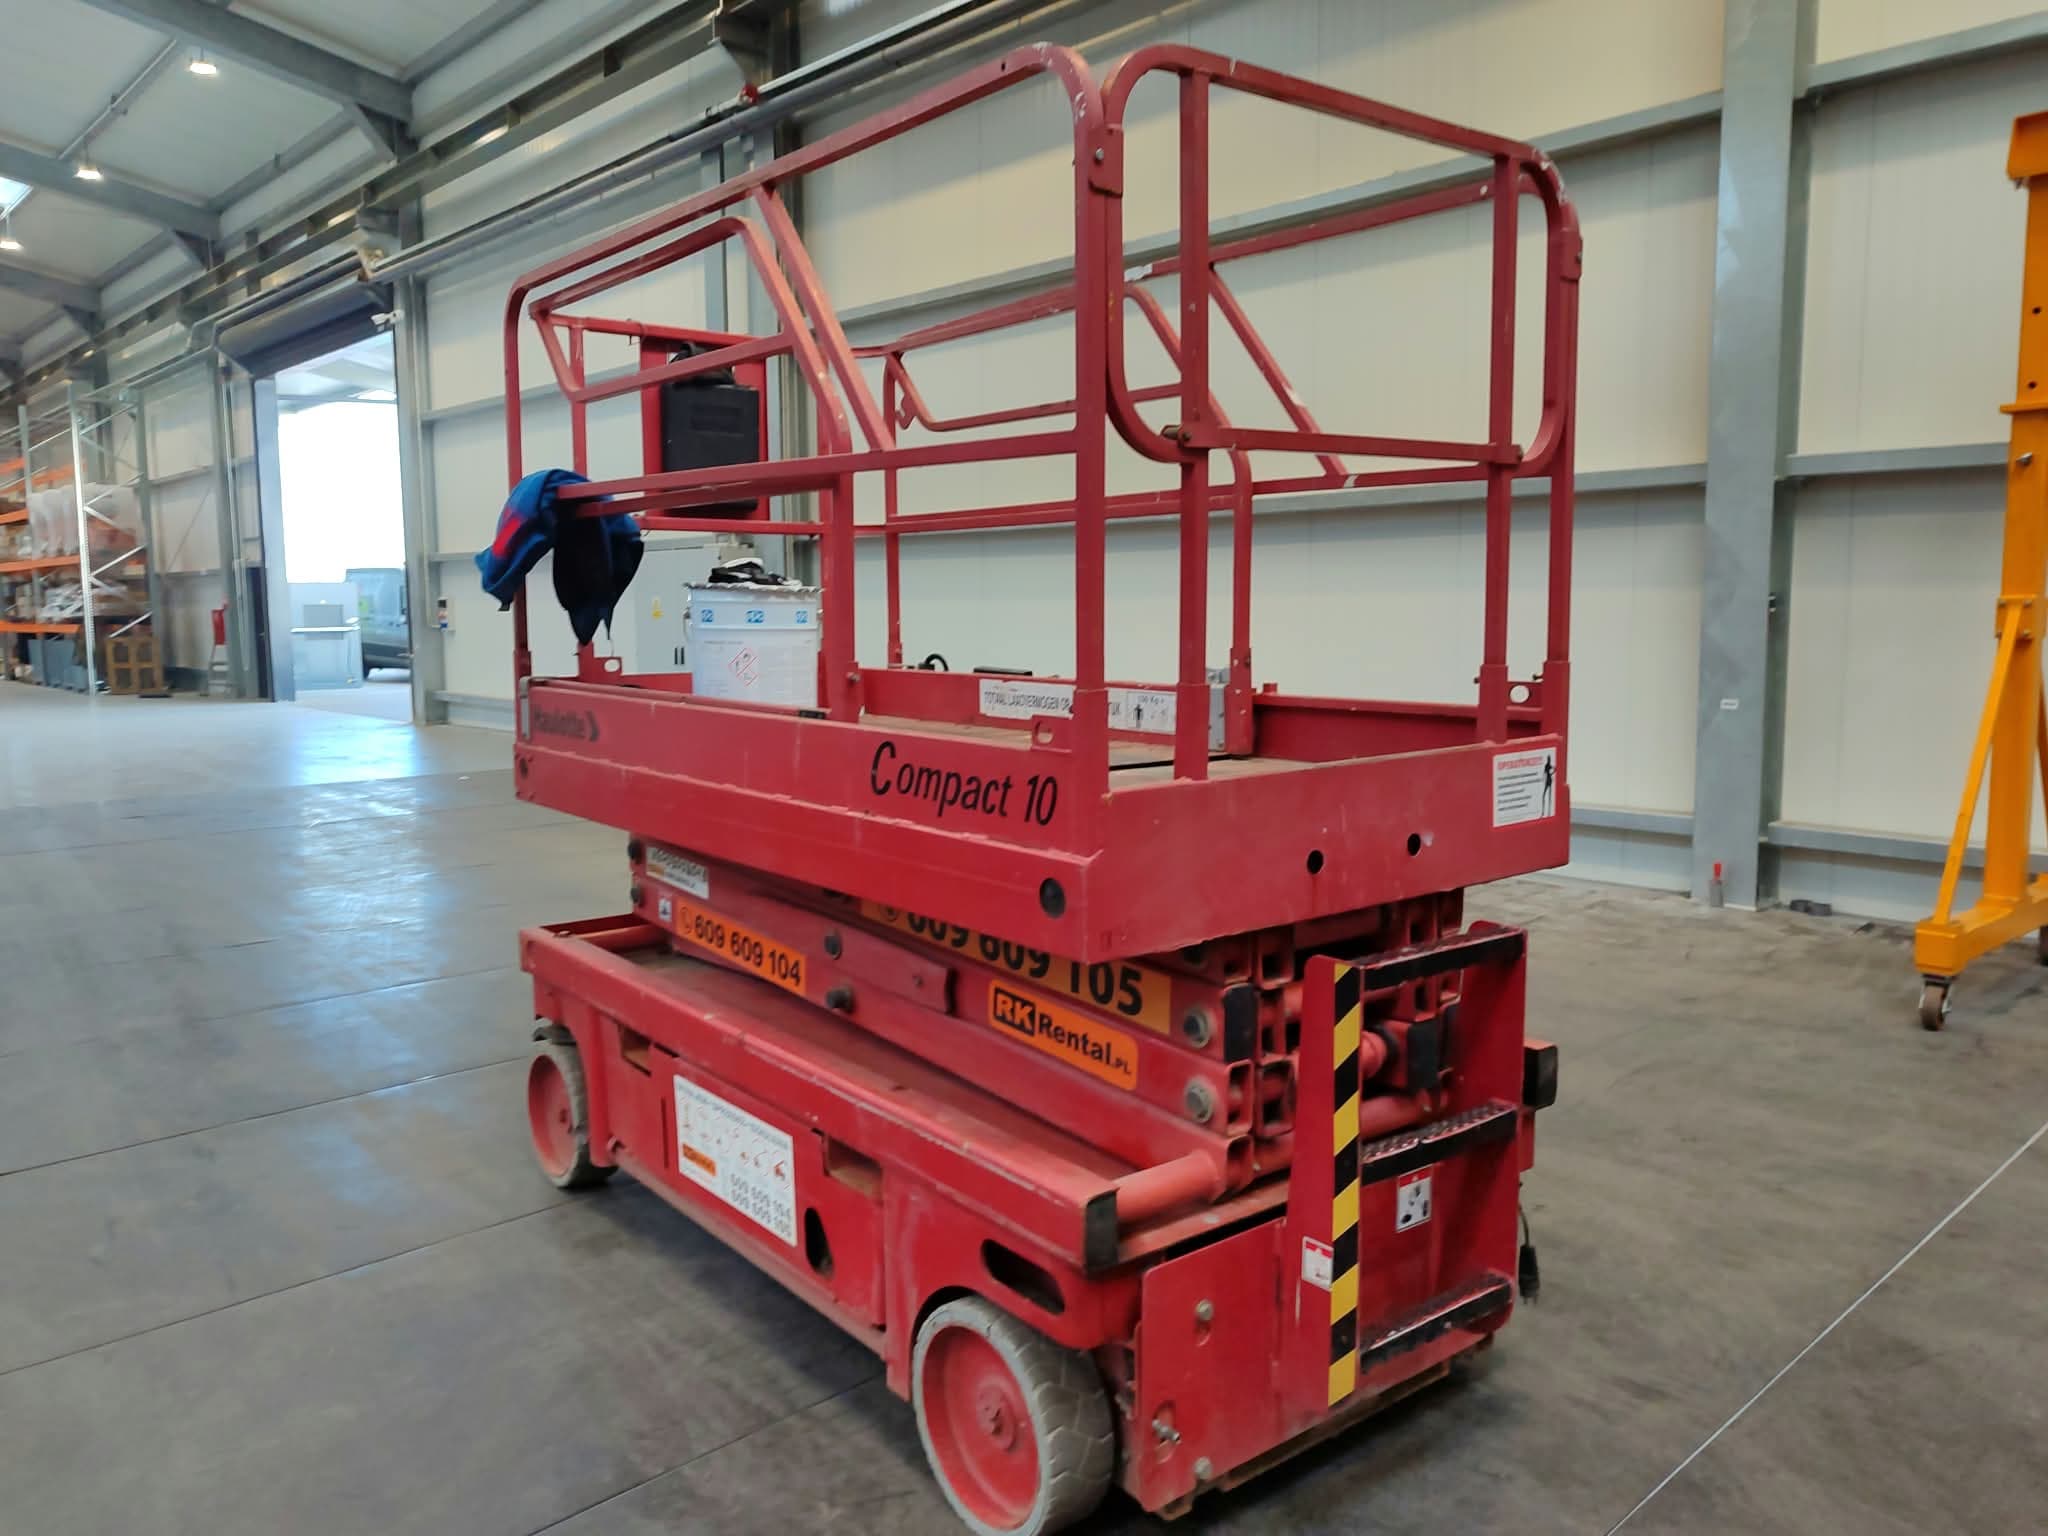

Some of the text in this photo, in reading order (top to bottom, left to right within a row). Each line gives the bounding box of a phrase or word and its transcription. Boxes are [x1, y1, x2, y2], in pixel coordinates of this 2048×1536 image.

[871, 740, 1058, 826] Compact 10
[695, 914, 802, 987] 609 609 104
[995, 988, 1036, 1036] RK
[1069, 961, 1142, 1016] 105
